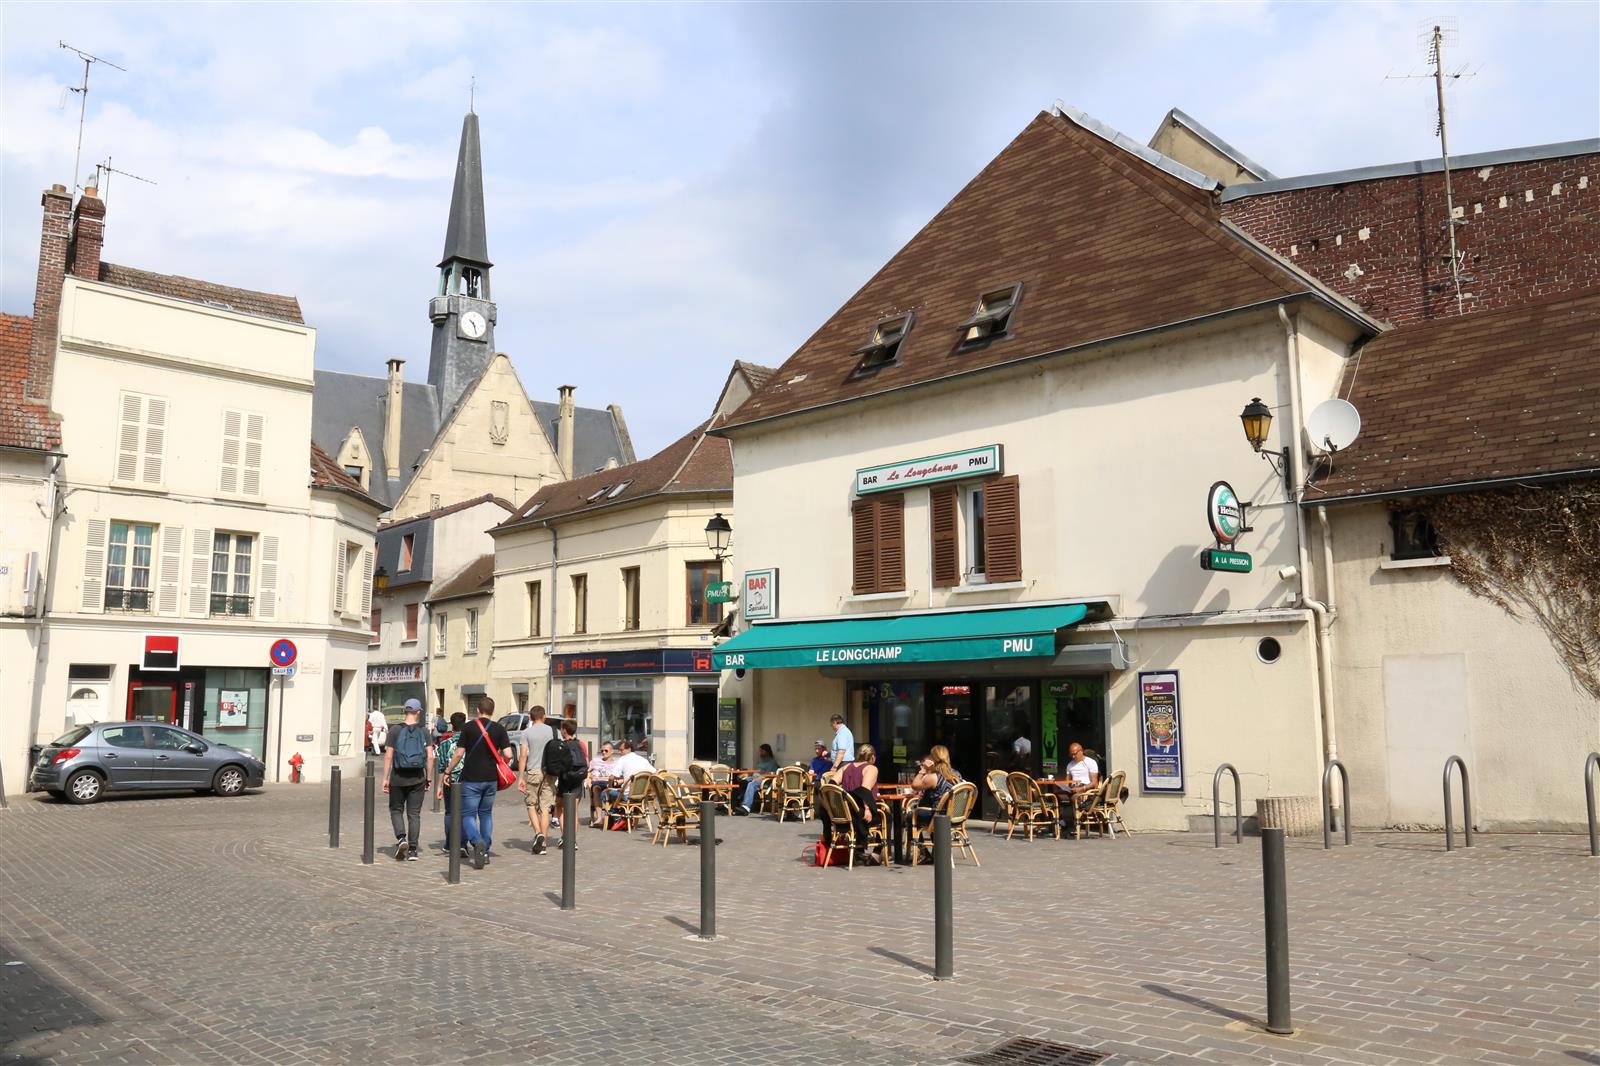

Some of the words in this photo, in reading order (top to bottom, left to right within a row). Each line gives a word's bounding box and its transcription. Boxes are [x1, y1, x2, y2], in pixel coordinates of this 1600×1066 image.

[862, 475, 878, 485] BAR
[886, 470, 900, 481] Le
[904, 463, 959, 478] Longchamp
[968, 456, 988, 467] PMU
[1229, 557, 1249, 566] PRESSION
[748, 577, 767, 590] BAR
[707, 589, 721, 598] PMU
[725, 654, 745, 666] BAR
[816, 650, 830, 662] LE
[831, 646, 902, 662] LONGCHAMP
[1003, 638, 1033, 653] PMU
[571, 658, 608, 669] REFLET
[696, 658, 710, 670] R
